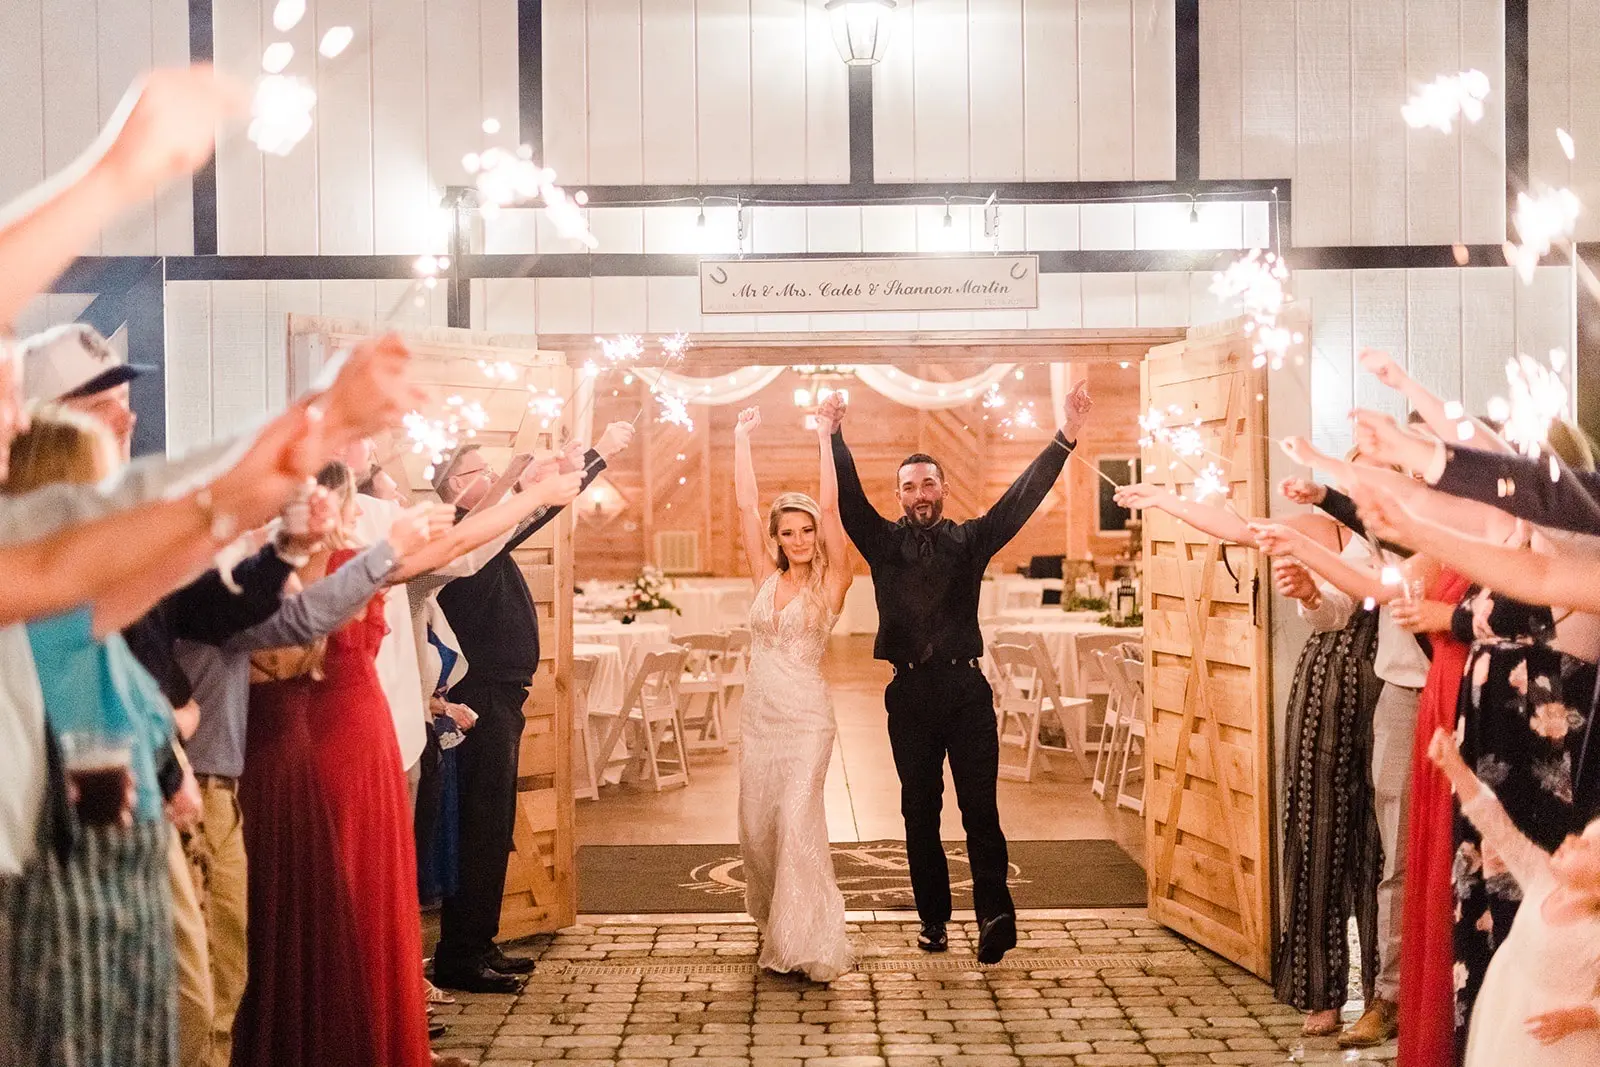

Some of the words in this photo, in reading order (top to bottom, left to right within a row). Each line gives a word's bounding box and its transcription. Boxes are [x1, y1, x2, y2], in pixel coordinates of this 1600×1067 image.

[732, 283, 757, 297] Mr
[762, 285, 774, 297] &
[775, 283, 812, 297] Mrs.
[818, 281, 862, 297] Caleb
[868, 283, 880, 296] &
[883, 280, 952, 296] Shannon
[955, 279, 1010, 294] Martin
